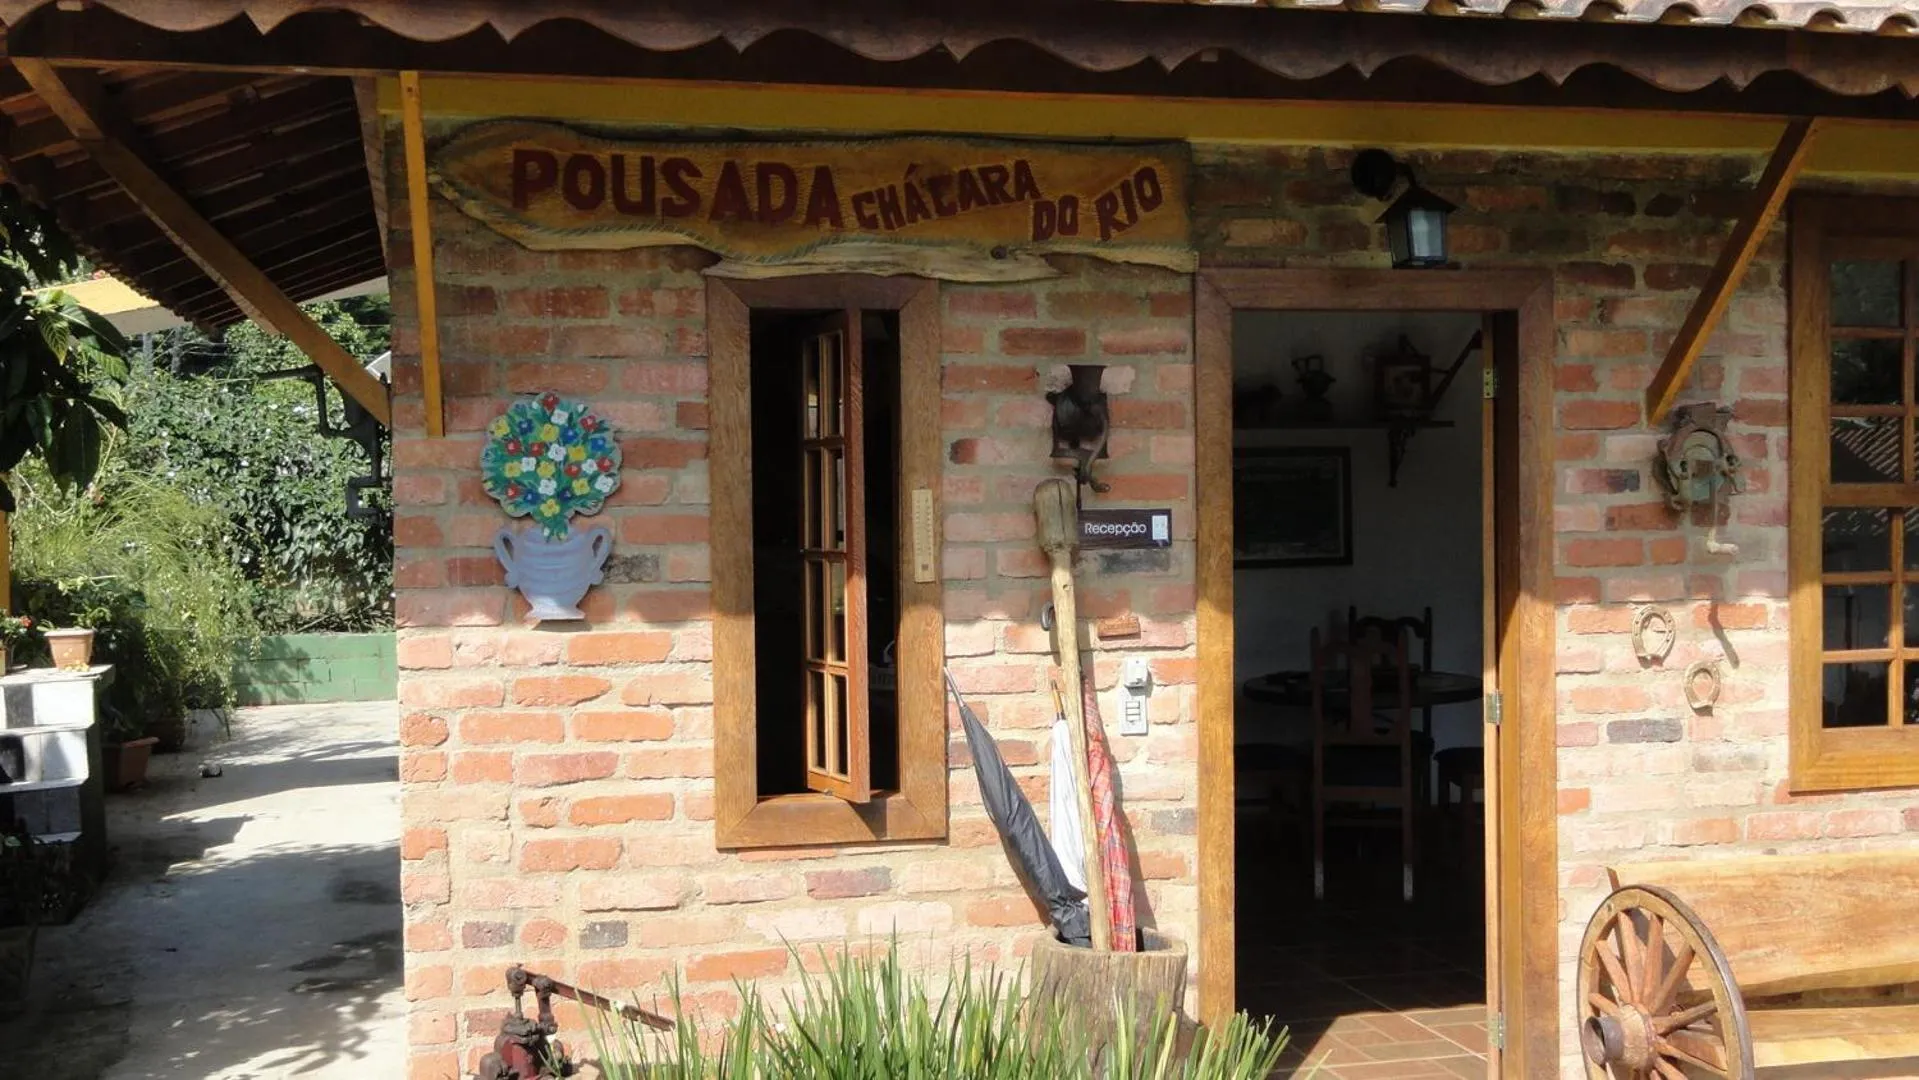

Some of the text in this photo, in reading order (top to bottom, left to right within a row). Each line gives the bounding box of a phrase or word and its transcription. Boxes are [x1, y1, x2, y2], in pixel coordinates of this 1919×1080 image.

[514, 149, 1163, 243] POUSADA CHÁCARA DO RIO
[1084, 522, 1147, 536] Recepção
